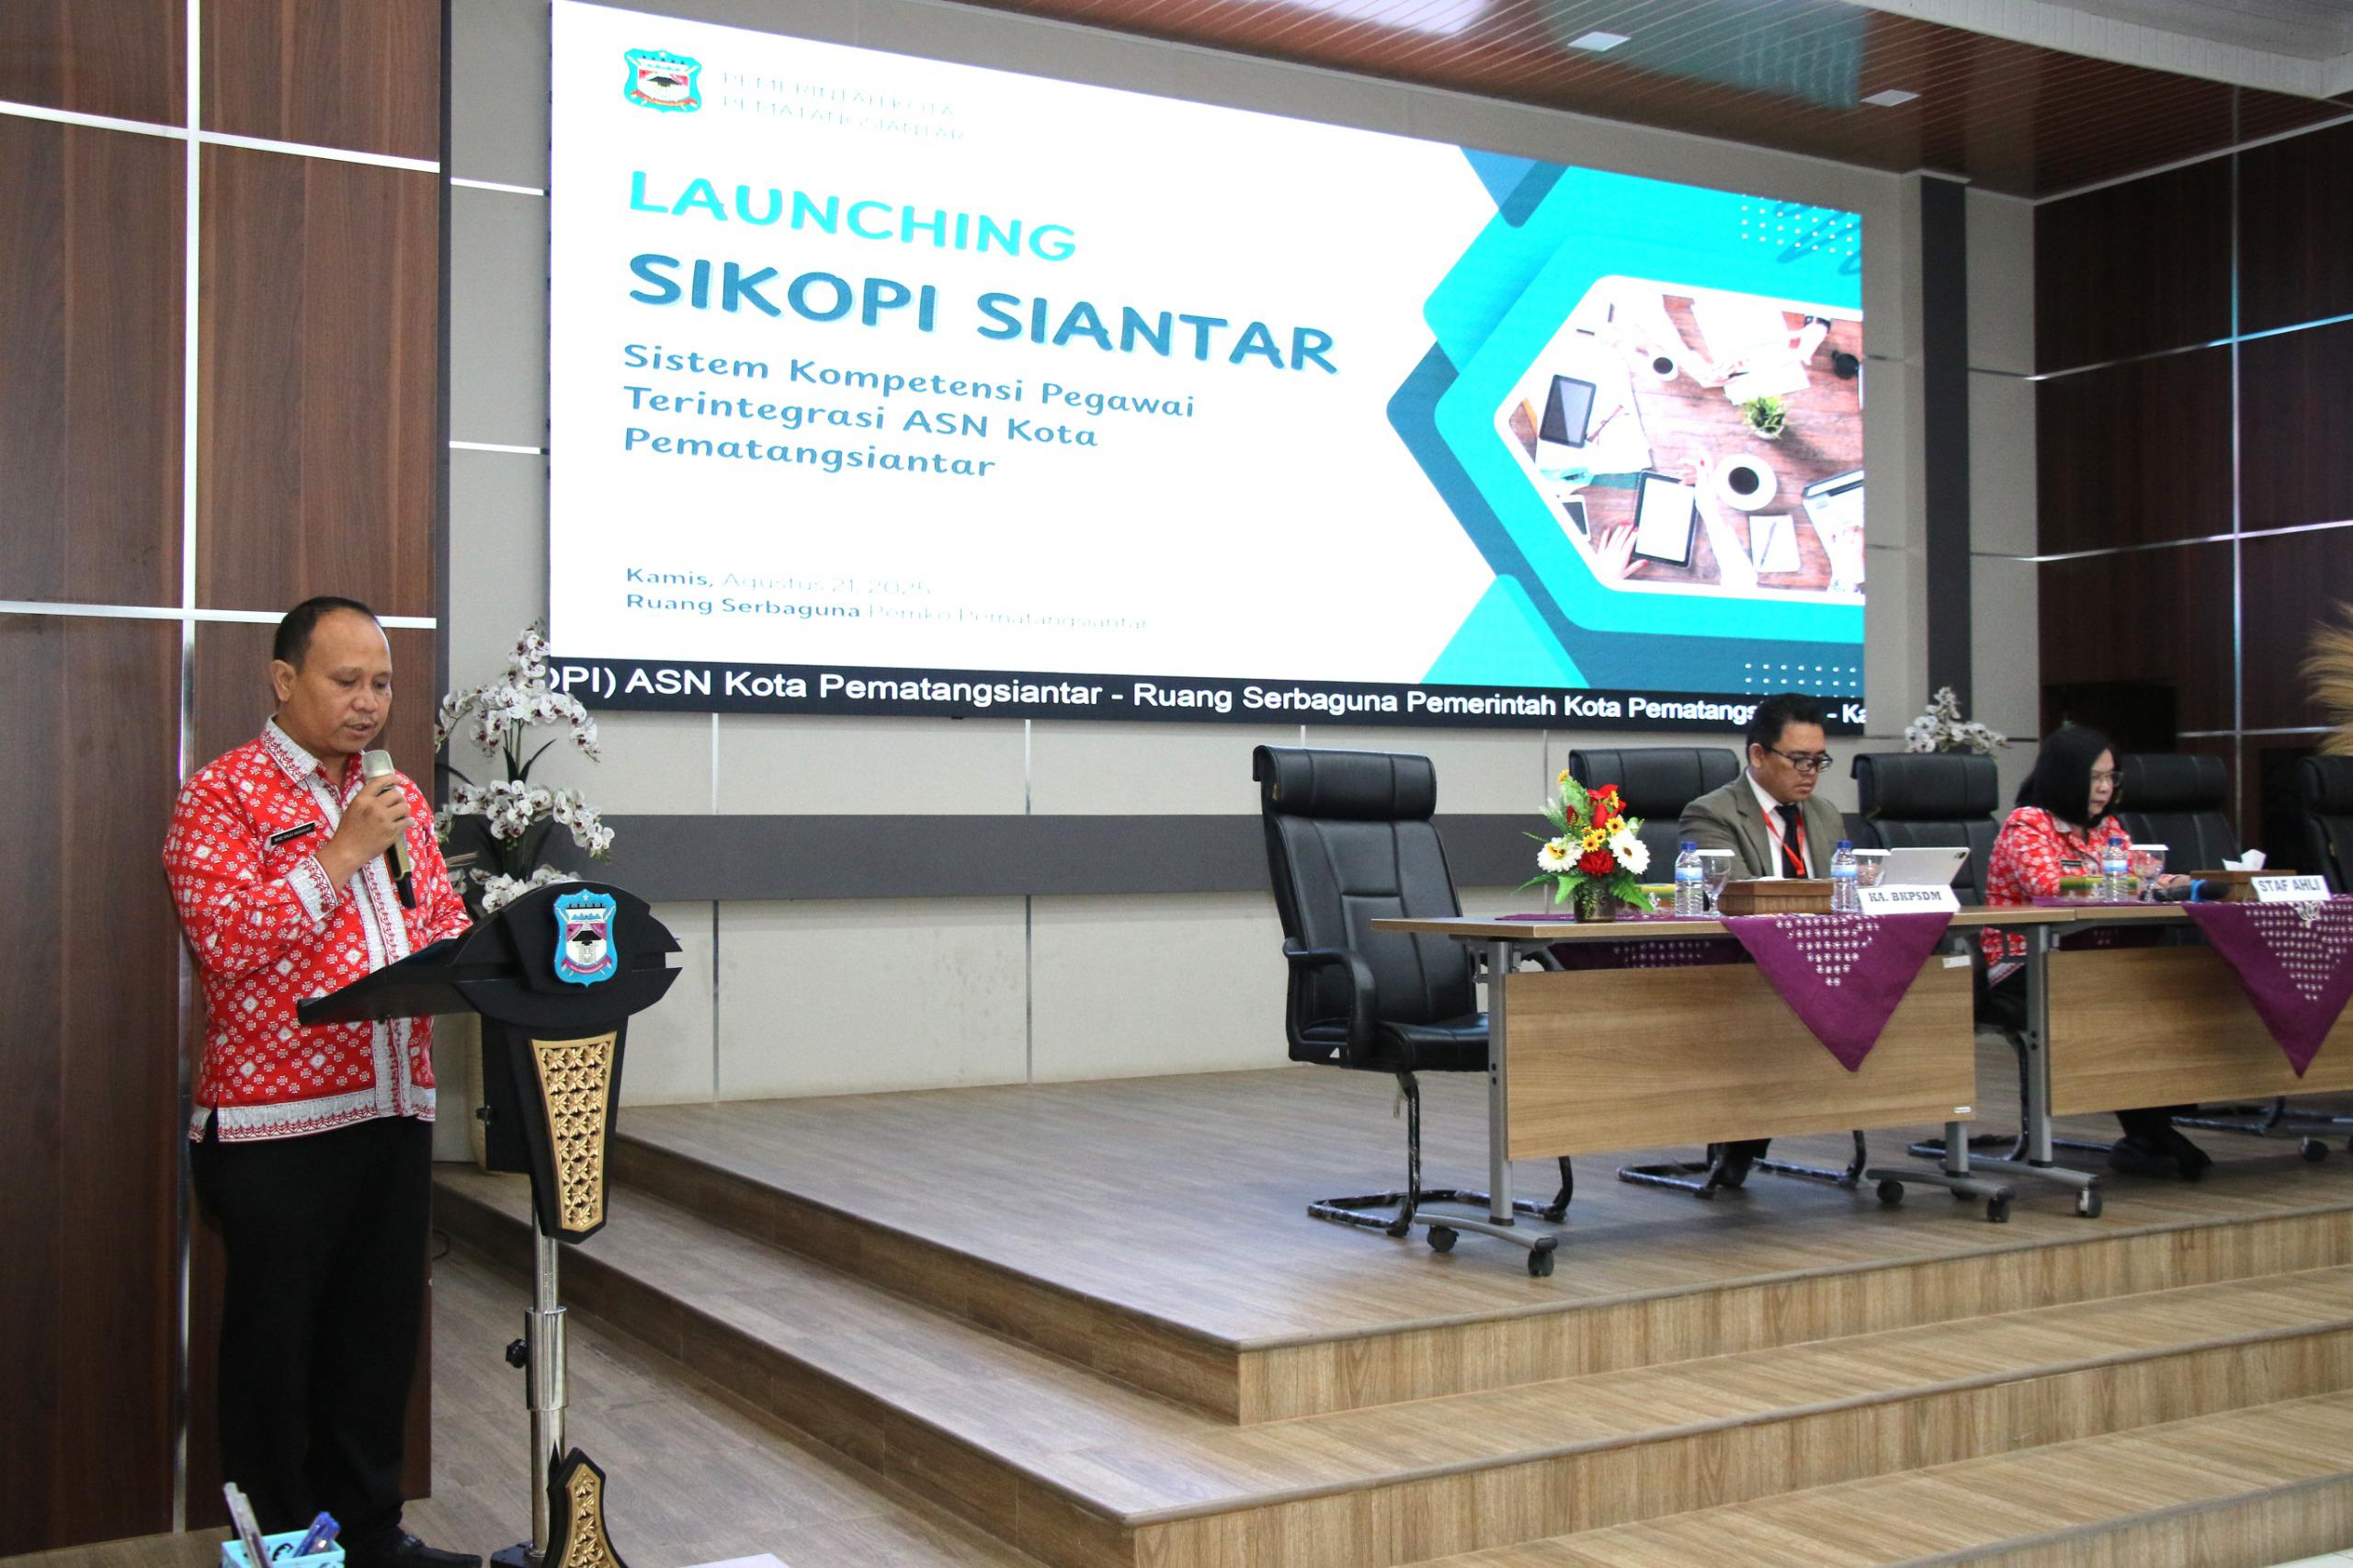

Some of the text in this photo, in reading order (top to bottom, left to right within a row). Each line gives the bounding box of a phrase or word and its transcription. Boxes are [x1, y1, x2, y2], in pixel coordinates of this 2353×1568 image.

[630, 170, 1076, 262] LAUNCHING
[629, 253, 1339, 375] SIKOPI SIANTAR
[623, 344, 1195, 418] Sistem Kompetensi Pegawai
[622, 385, 1098, 447] Terintegrasi ASN Kota
[625, 426, 996, 477] Pematangsiantar
[627, 567, 713, 587] Kamis,
[627, 594, 713, 615] Ruang
[722, 597, 860, 619] Serbaguna
[624, 668, 711, 696] ASN
[725, 670, 807, 698] Kota
[820, 673, 1103, 708] Pematangsiantar
[1133, 683, 1233, 713] Ruang
[1242, 686, 1398, 716] Serbaguna
[1407, 690, 1556, 717] Pemerintah
[1564, 695, 1621, 719] Kota
[1628, 697, 1764, 725] Pematangs
[1868, 890, 1942, 903] KA. BKPSDM
[2257, 878, 2322, 892] STAF AHLI
